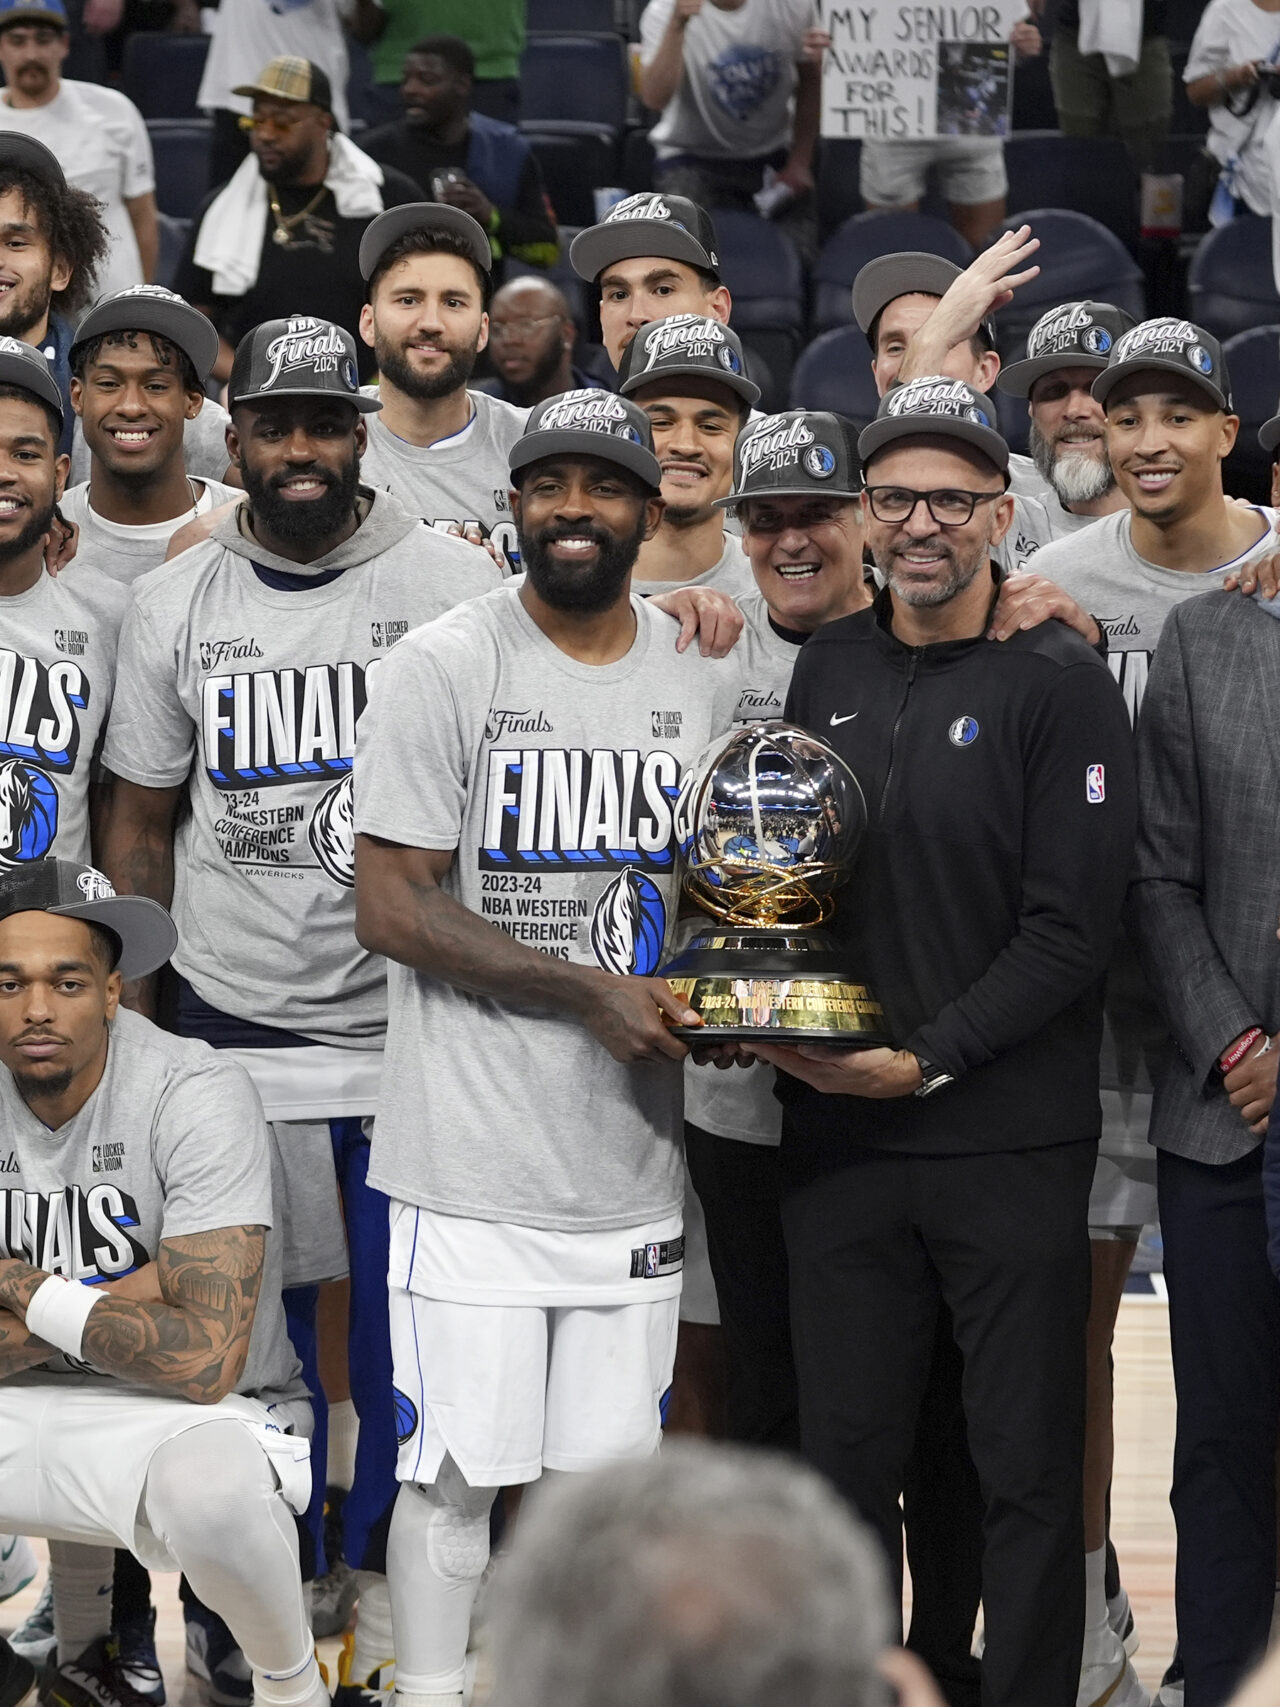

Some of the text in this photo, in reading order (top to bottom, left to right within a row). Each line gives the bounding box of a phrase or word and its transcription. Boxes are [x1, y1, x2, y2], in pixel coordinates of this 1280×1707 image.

[829, 5, 1003, 43] MY SENIOR
[823, 47, 934, 80] AWARDS
[845, 80, 898, 105] FOR
[287, 318, 318, 334] NBA
[644, 318, 726, 374] Finals
[687, 343, 715, 358] 2024
[1052, 331, 1078, 353] 2024
[1117, 320, 1200, 364] Finals
[1153, 340, 1185, 354] 2024
[260, 325, 347, 391] Finals
[314, 356, 338, 374] 2024
[887, 379, 976, 417] Finals
[929, 401, 961, 416] 2024
[538, 394, 628, 432] Finals
[582, 419, 613, 434] 2024
[737, 416, 815, 494] Finals
[769, 448, 800, 471] 2024
[66, 629, 90, 645] LOCKER
[384, 620, 409, 635] LOCKER
[67, 642, 86, 657] ROOM
[206, 635, 265, 673] Finals
[203, 658, 382, 773] FINAL
[488, 708, 554, 744] Finals
[662, 711, 683, 725] LOCKER
[663, 724, 681, 739] ROOM
[482, 749, 681, 854] FINALS
[214, 818, 296, 847] CONFERENCE
[245, 869, 305, 880] MAVERICKS
[481, 874, 542, 894] 2023-24
[481, 896, 588, 918] NBA WESTERN
[699, 995, 737, 1010] 2023-24
[758, 995, 804, 1011] WESTERN
[805, 997, 857, 1014] CONFERENCE
[102, 1141, 125, 1157] LOCKER
[103, 1156, 124, 1172] ROOM
